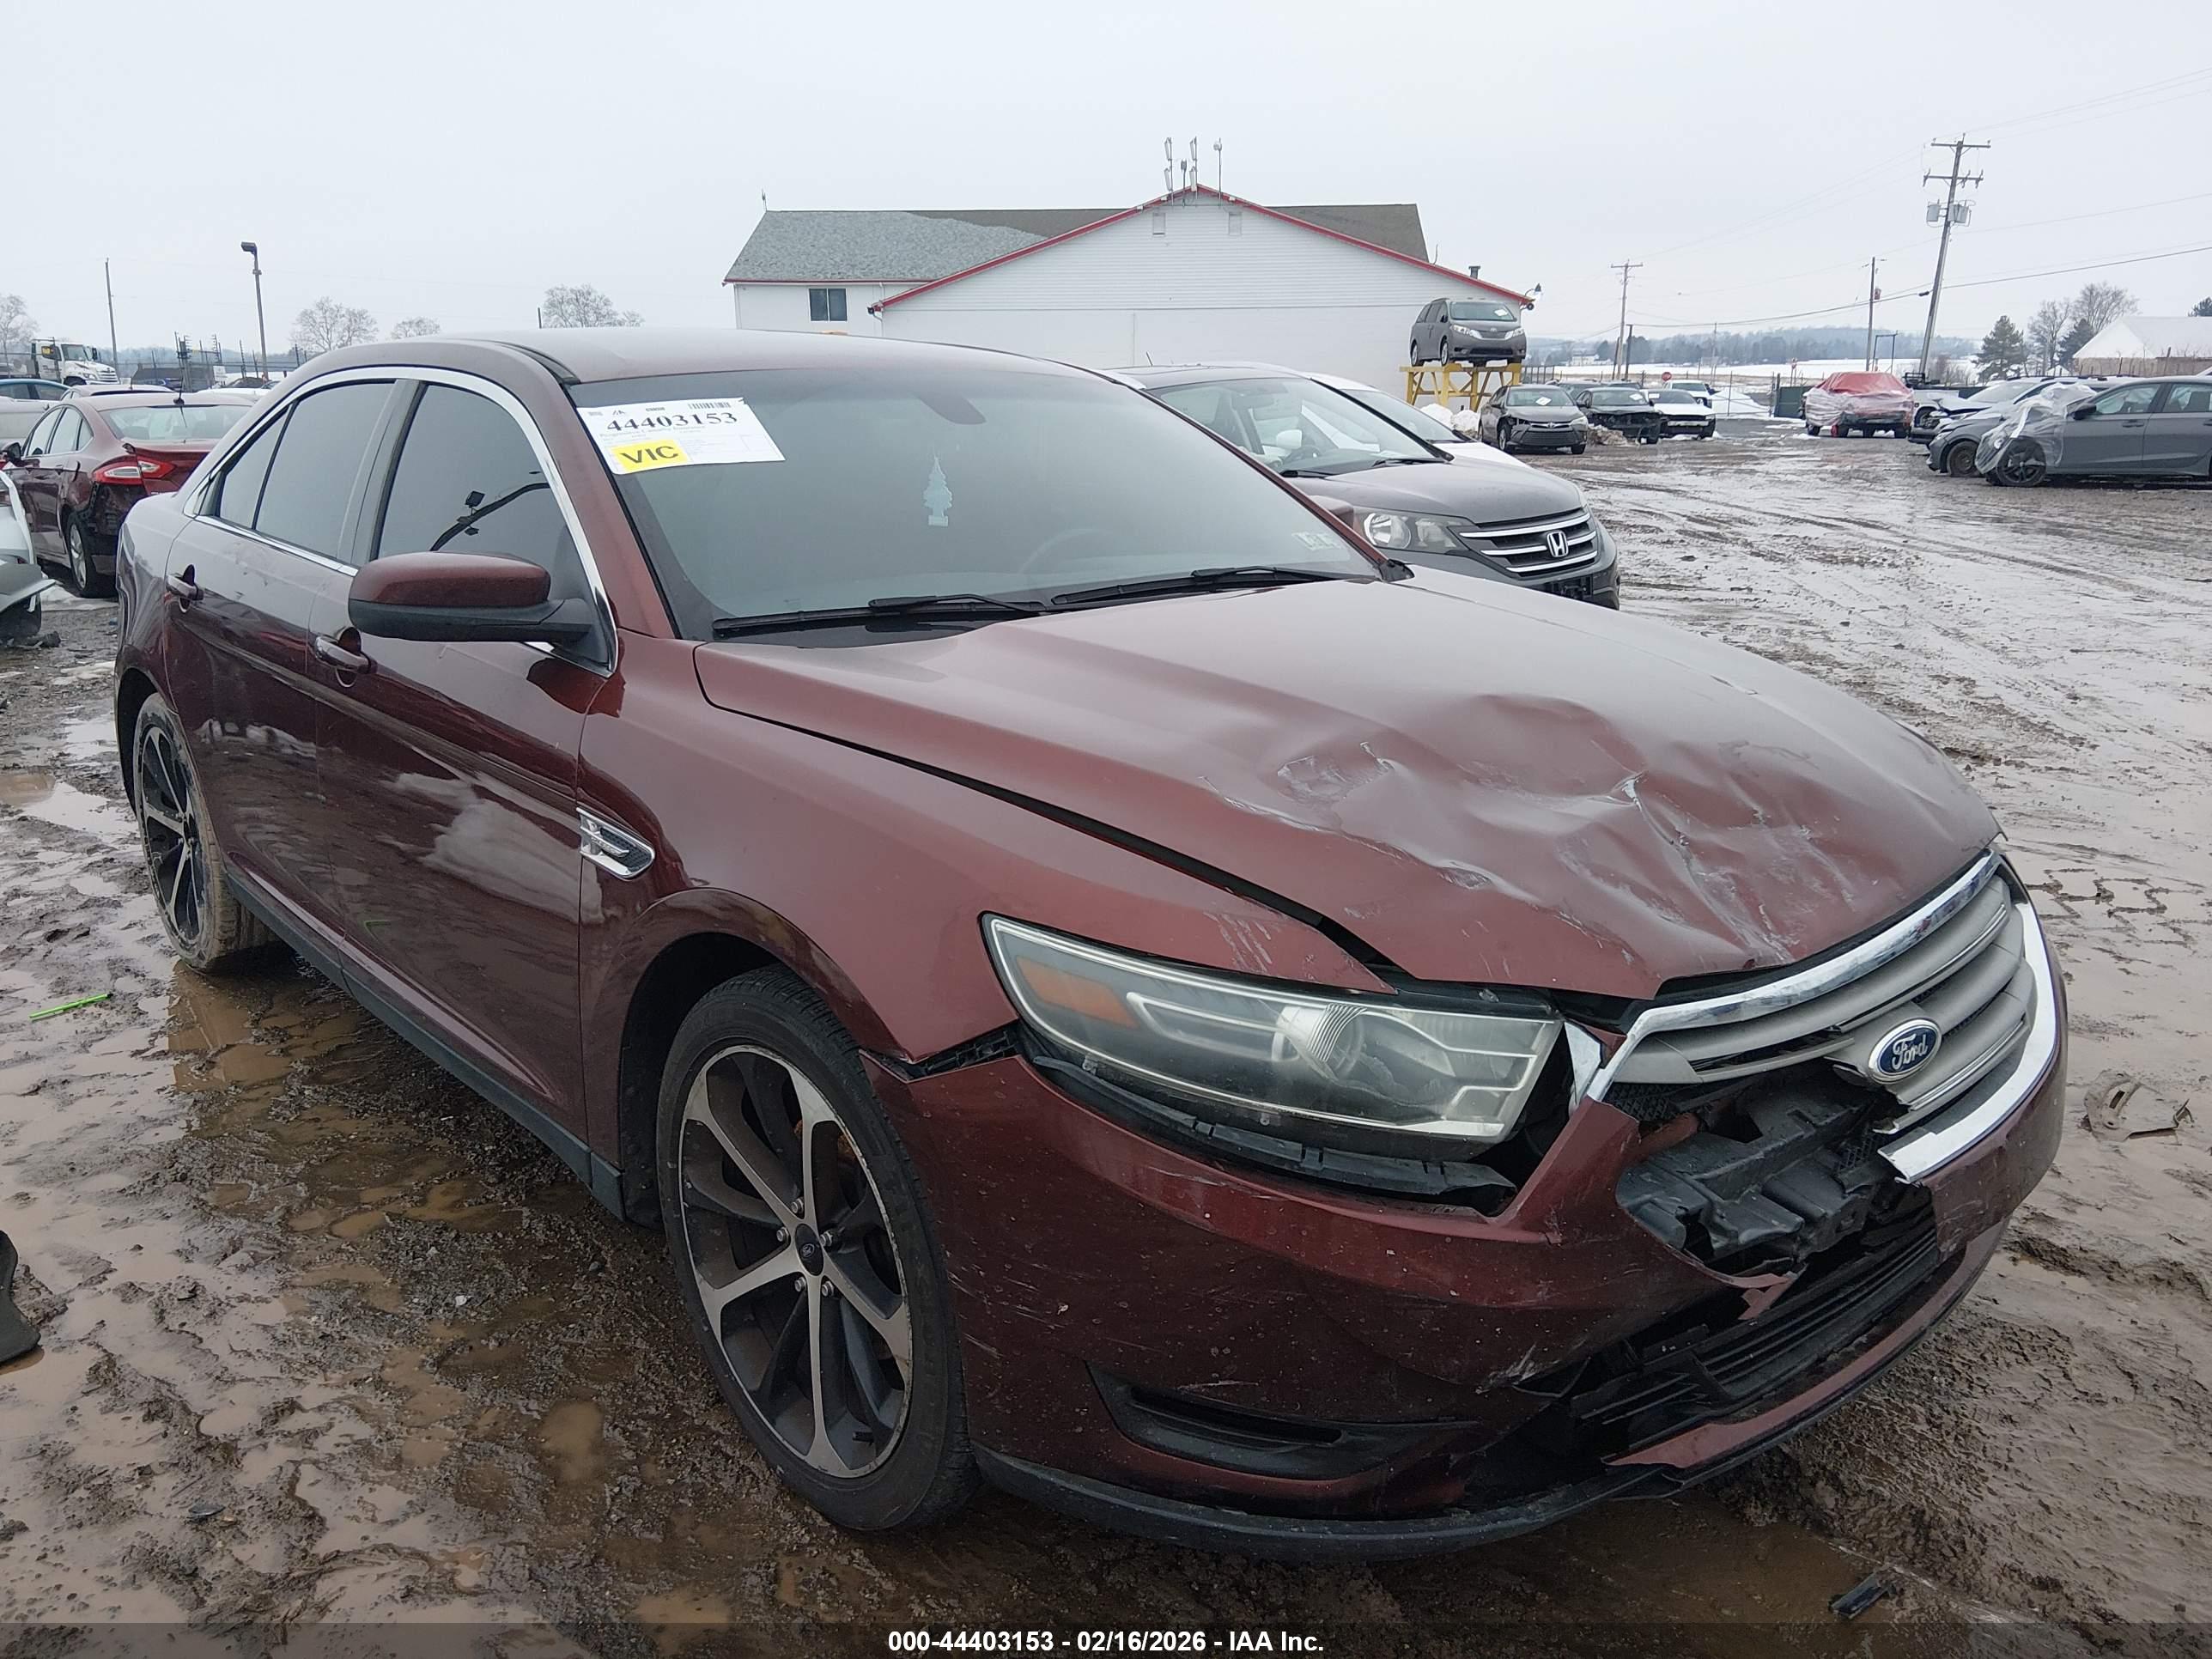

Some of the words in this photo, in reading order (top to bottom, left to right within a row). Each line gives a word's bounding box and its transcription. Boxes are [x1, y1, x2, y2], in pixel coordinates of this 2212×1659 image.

[608, 412, 738, 431] 44403153
[621, 446, 678, 464] VIC
[1892, 1034, 1928, 1070] Ford
